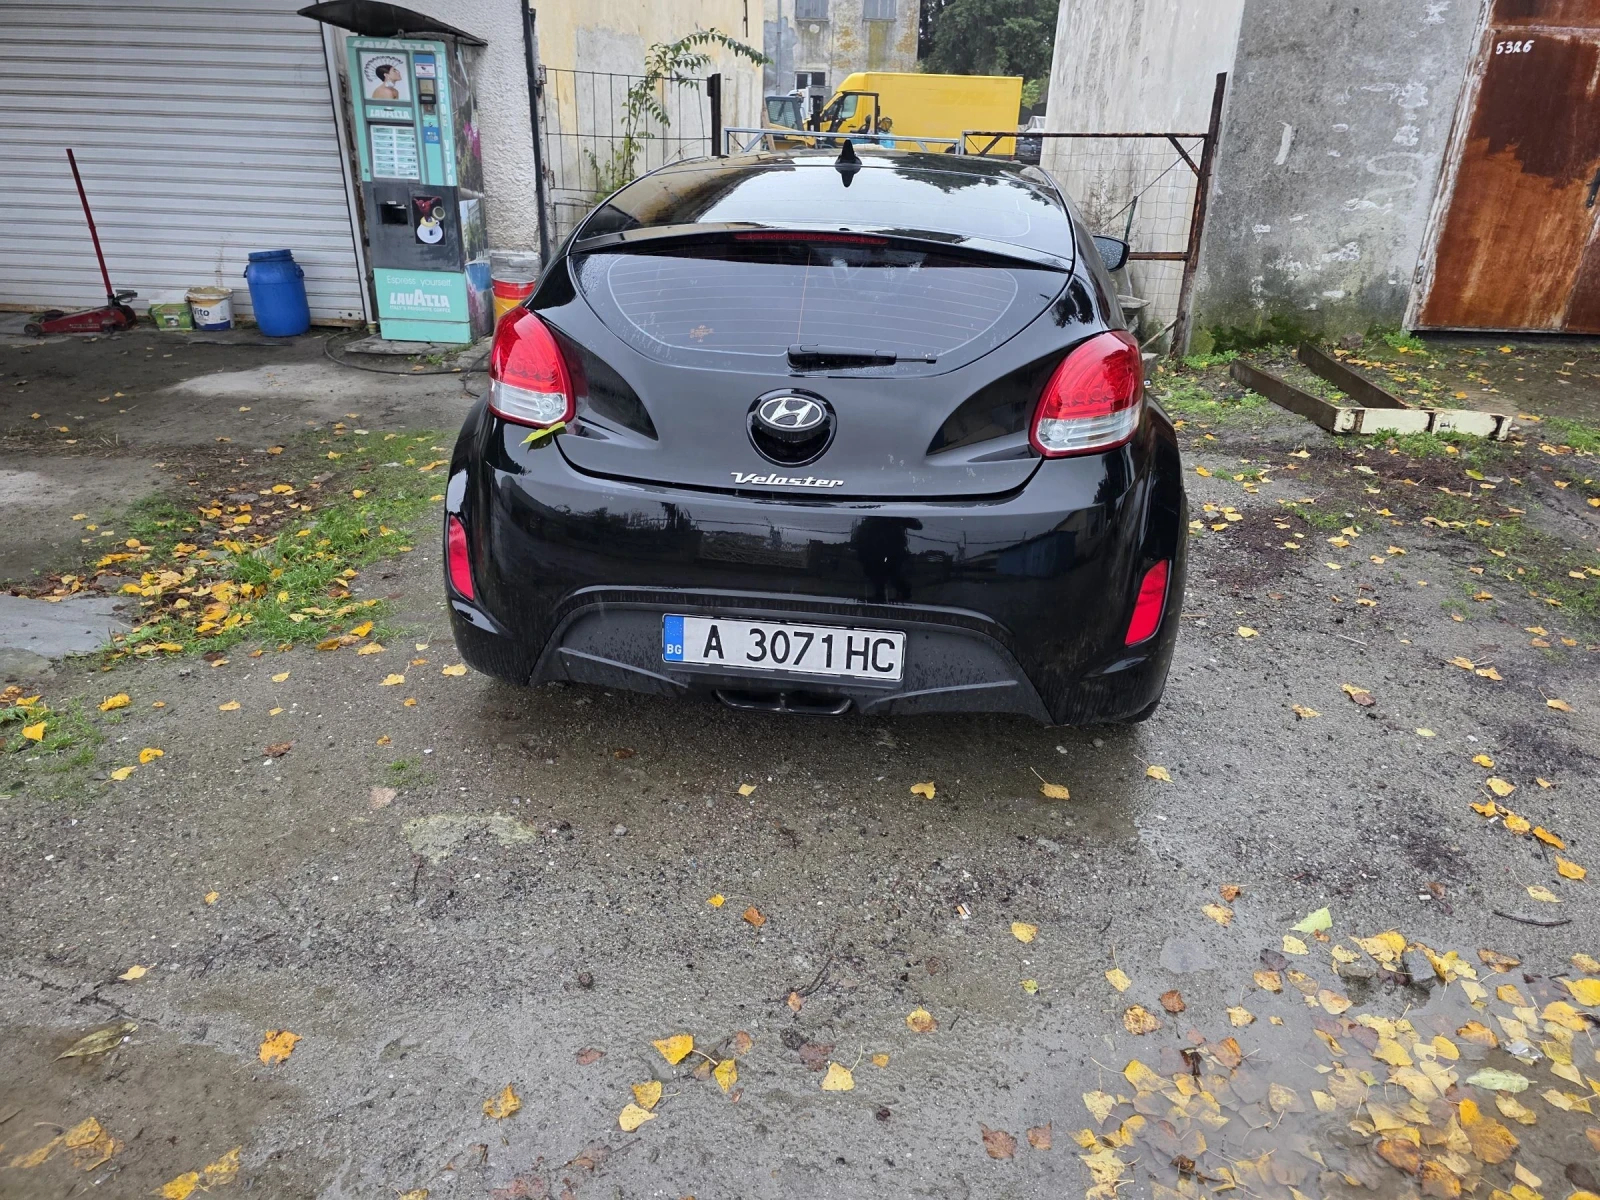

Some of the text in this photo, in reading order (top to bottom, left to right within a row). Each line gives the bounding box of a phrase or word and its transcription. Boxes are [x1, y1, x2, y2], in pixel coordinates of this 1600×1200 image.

[353, 39, 436, 51] LAVAZZA
[1495, 39, 1535, 55] 5326
[370, 108, 410, 119] LAVAZZA
[443, 139, 454, 186] УТРО
[386, 275, 452, 287] Espress yourself.
[389, 289, 450, 308] LAVAZZA
[192, 306, 210, 317] Vito
[730, 471, 844, 488] Veloster
[702, 624, 725, 659] A
[666, 643, 682, 655] BG
